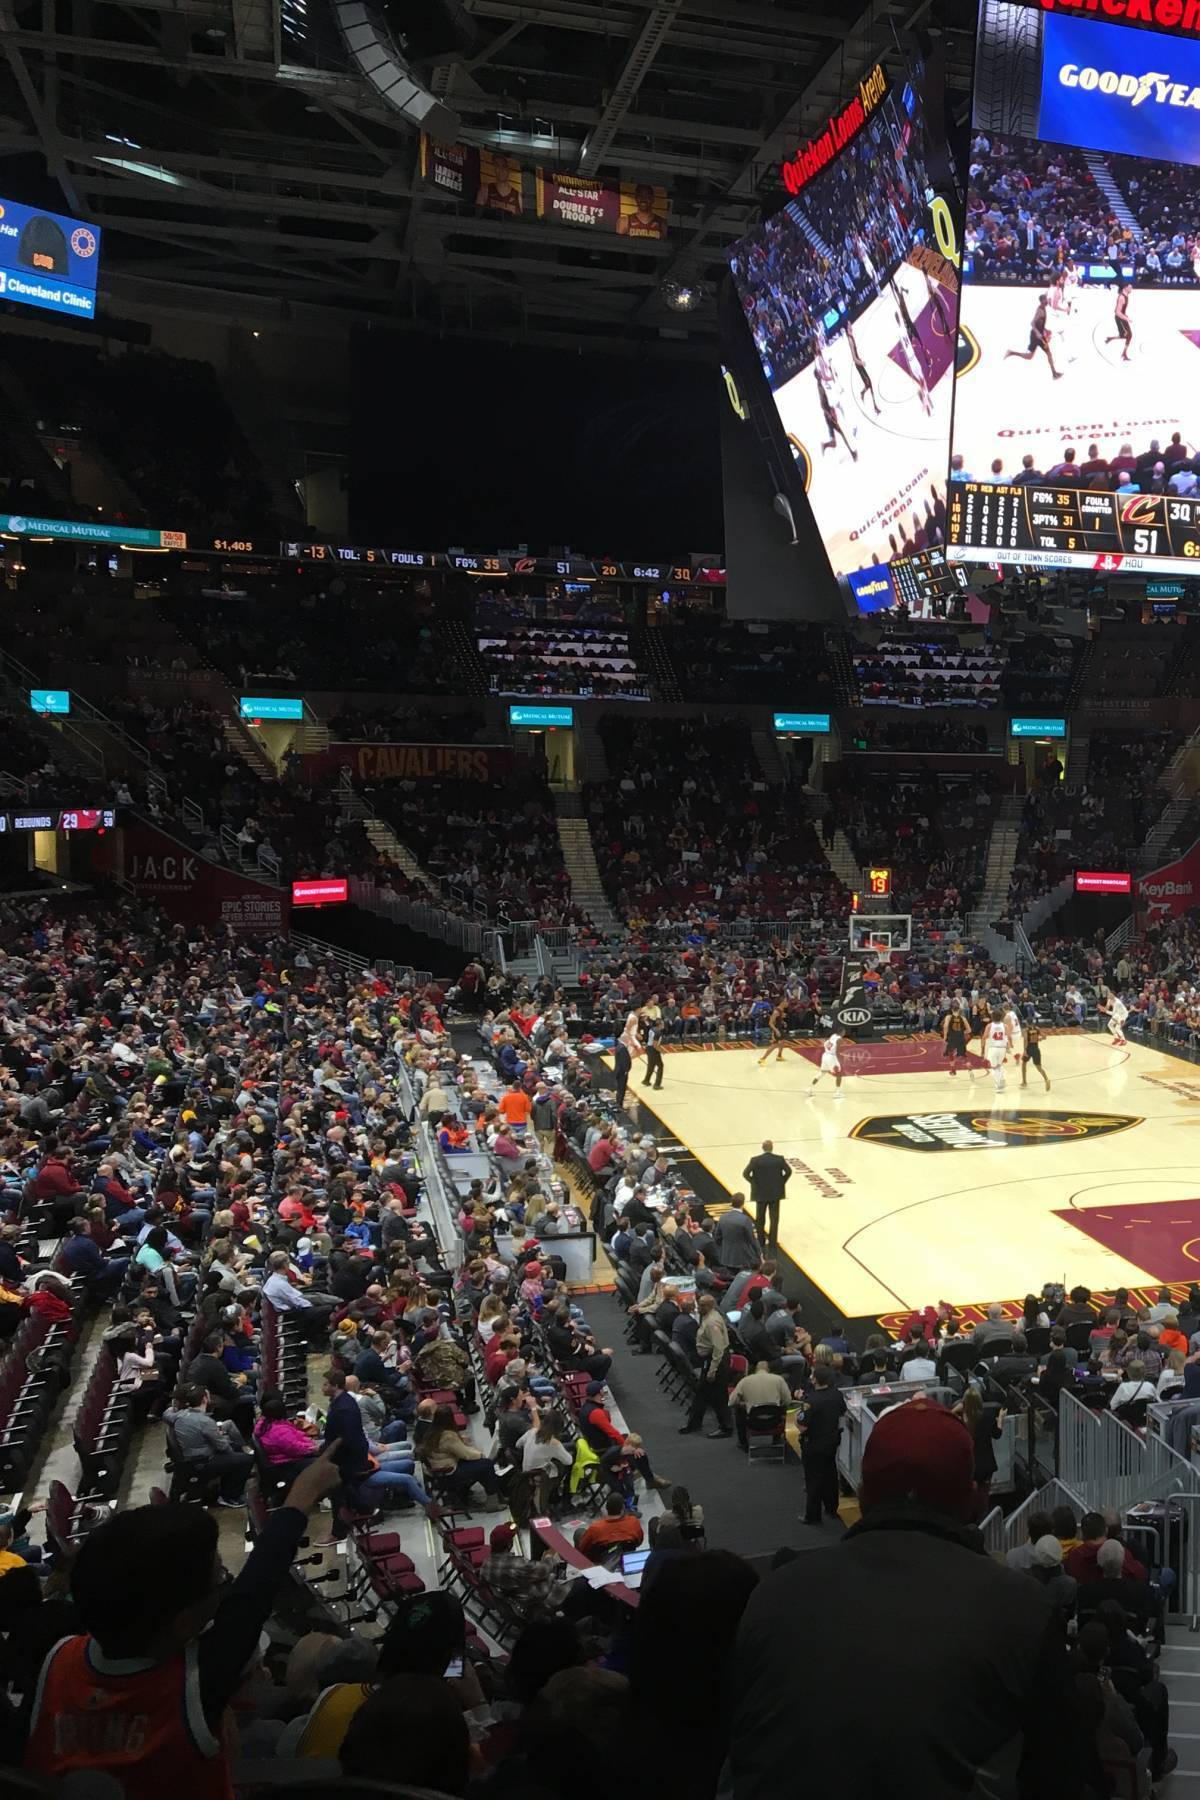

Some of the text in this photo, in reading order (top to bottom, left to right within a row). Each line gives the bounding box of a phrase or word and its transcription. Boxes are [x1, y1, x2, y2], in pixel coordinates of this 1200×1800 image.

[783, 64, 886, 195] Quicken Loans Arena
[553, 200, 588, 214] DOUBLE
[561, 210, 596, 225] TROOPS
[0, 224, 19, 237] Hat
[8, 278, 92, 309] Cleveland Clinic
[1033, 492, 1069, 505] FG% 35
[1086, 497, 1109, 506] FOULS
[1170, 503, 1190, 521] 3Q
[1033, 514, 1073, 526] 3PT% 31
[27, 521, 110, 537] MEDICAL MUTUAL
[163, 532, 183, 540] 50/50
[1134, 529, 1157, 554] 51
[214, 539, 252, 551] $1,405
[1040, 537, 1075, 548] TOL 5
[304, 546, 324, 558] -13
[338, 549, 374, 562] TOL: 5
[392, 552, 423, 564] FOULS
[997, 552, 1072, 563] OUT TOWN SCORES
[456, 558, 499, 569] FG% 35
[557, 562, 570, 574] 51
[1126, 560, 1143, 568] HOU
[602, 566, 616, 575] 20
[634, 567, 659, 578] 6:42
[955, 567, 968, 588] 51
[358, 747, 488, 782] CAVALIERS
[15, 817, 51, 828] REBOUNDS
[63, 813, 78, 828] 29
[873, 879, 885, 893] 19
[1140, 881, 1193, 897] KeyBank
[221, 901, 281, 912] EPIC STORIES
[245, 913, 263, 921] START
[843, 1012, 866, 1021] KIA
